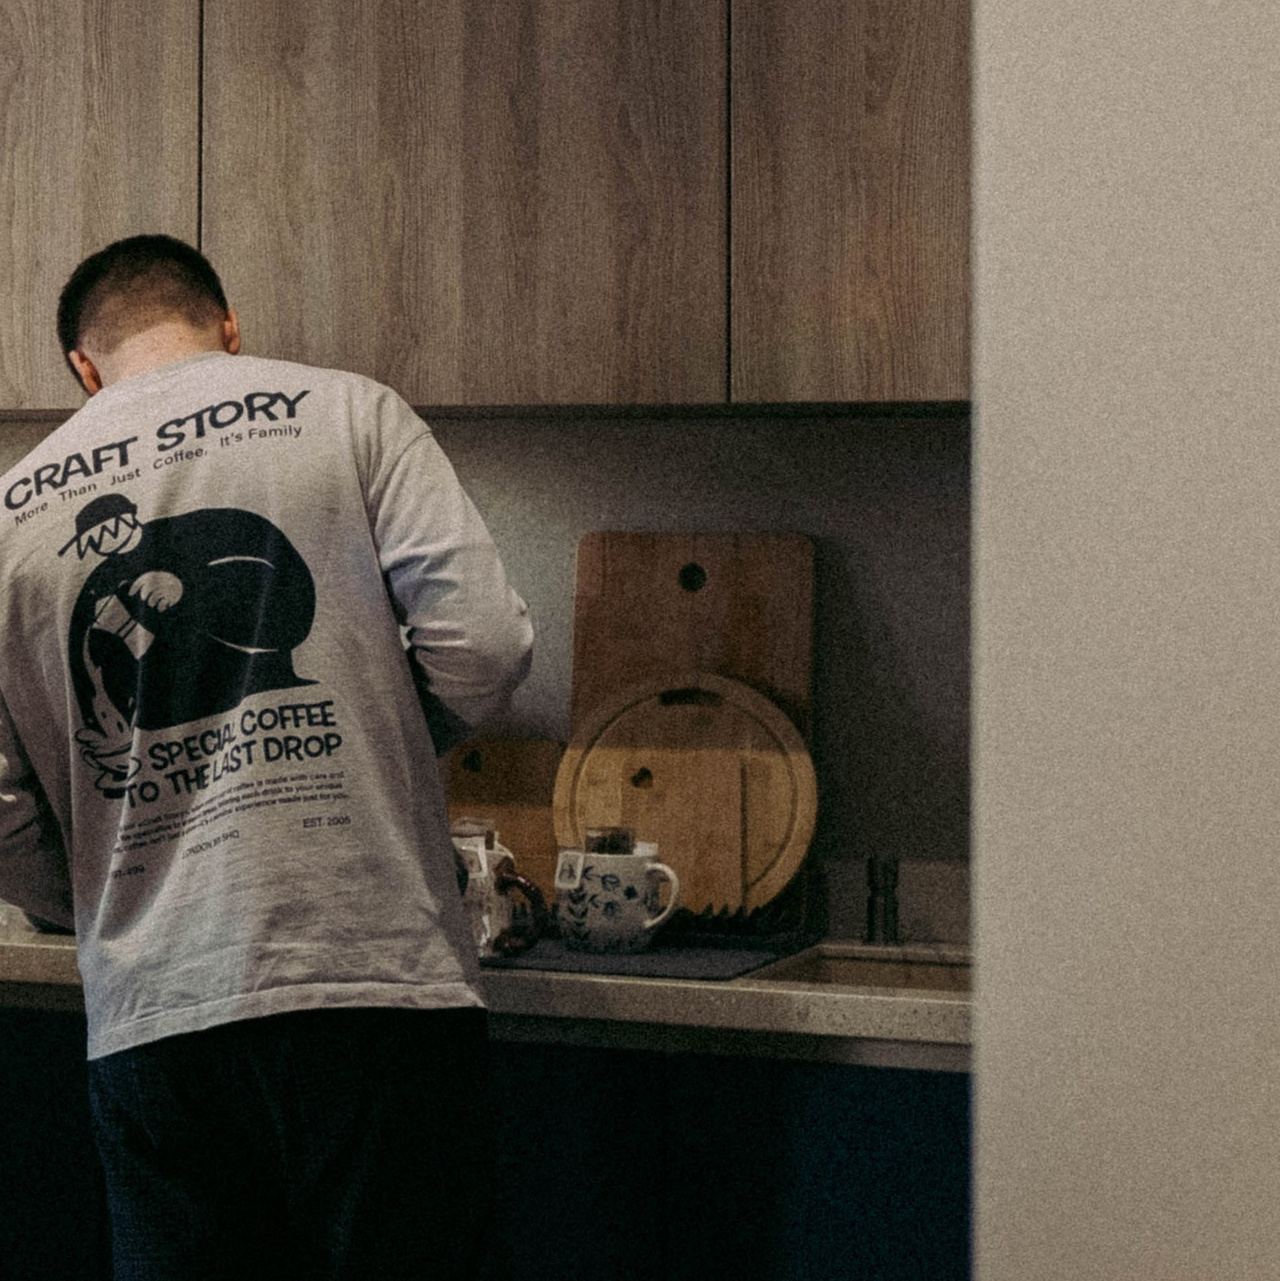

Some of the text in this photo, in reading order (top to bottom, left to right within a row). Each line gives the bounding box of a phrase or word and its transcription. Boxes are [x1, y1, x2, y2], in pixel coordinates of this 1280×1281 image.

[4, 390, 311, 510] CRAFT STORY
[14, 502, 49, 527] More
[58, 482, 97, 502] Than
[110, 468, 141, 486] Just
[220, 432, 243, 447] It's
[248, 424, 302, 439] Family
[240, 701, 337, 735] COFFEE
[125, 732, 343, 808] TO THE LAST DROP
